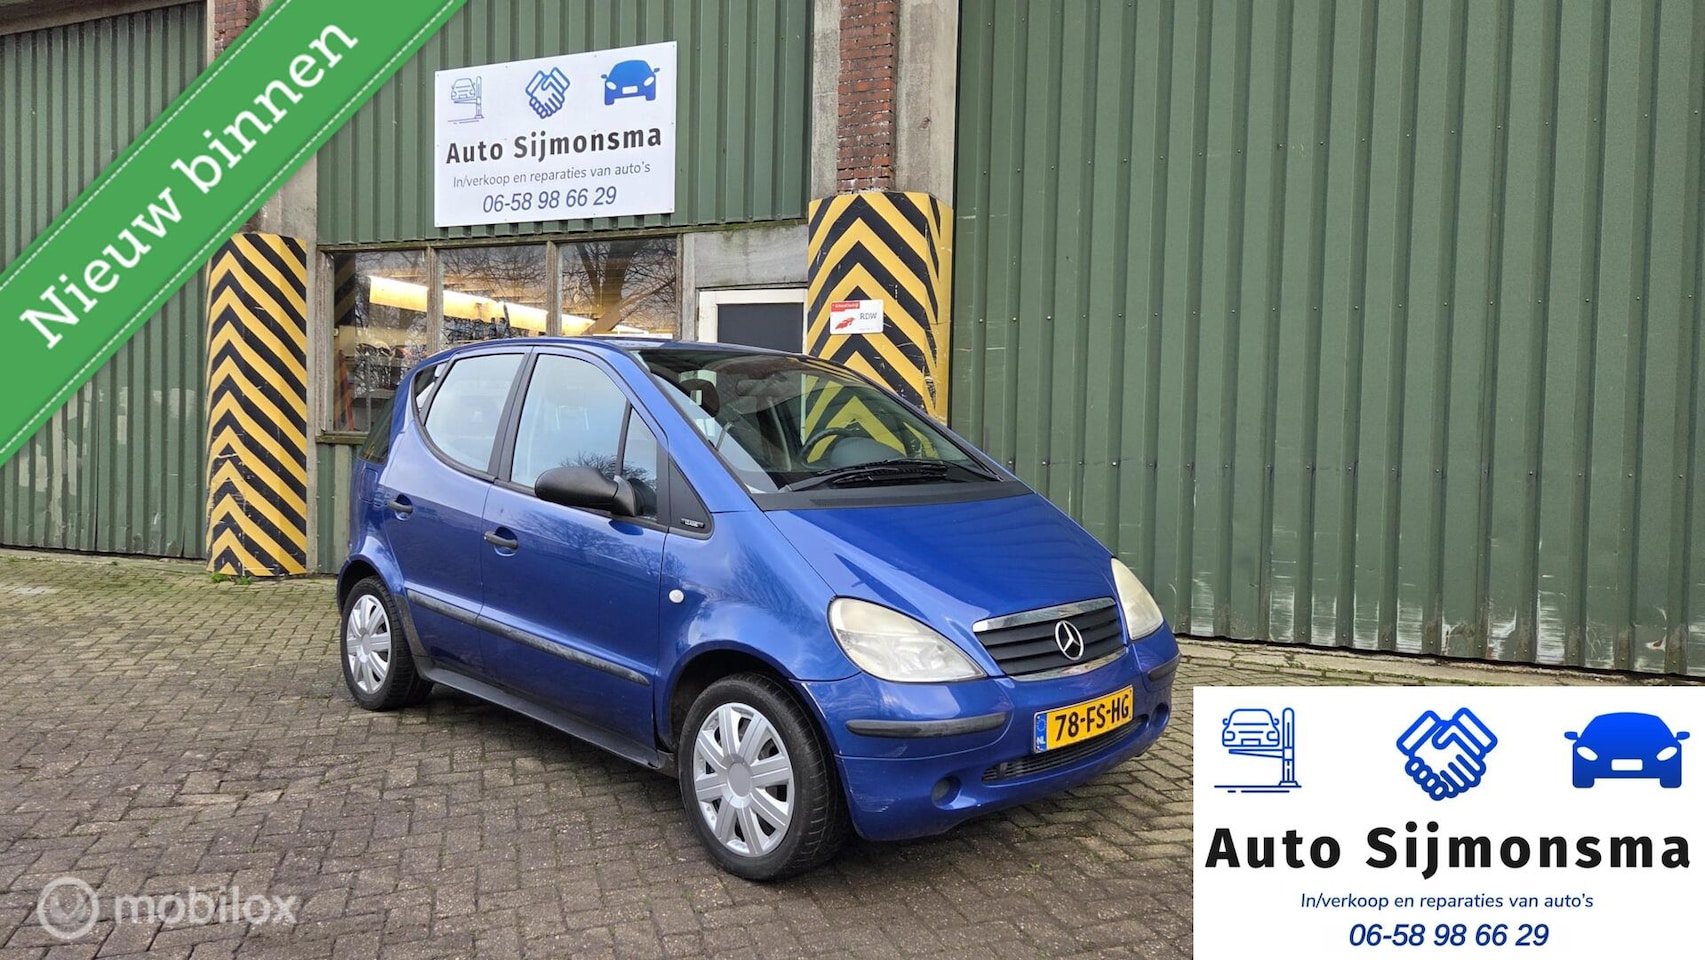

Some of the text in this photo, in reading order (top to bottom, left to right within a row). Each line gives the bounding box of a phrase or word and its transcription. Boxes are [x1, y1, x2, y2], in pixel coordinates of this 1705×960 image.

[447, 127, 661, 164] Auto Sijmonsma
[453, 161, 651, 188] In/verkoop en reparaties van auto's
[483, 186, 617, 213] 06-58 98 66 29
[1055, 694, 1129, 742] 78-FS-HG
